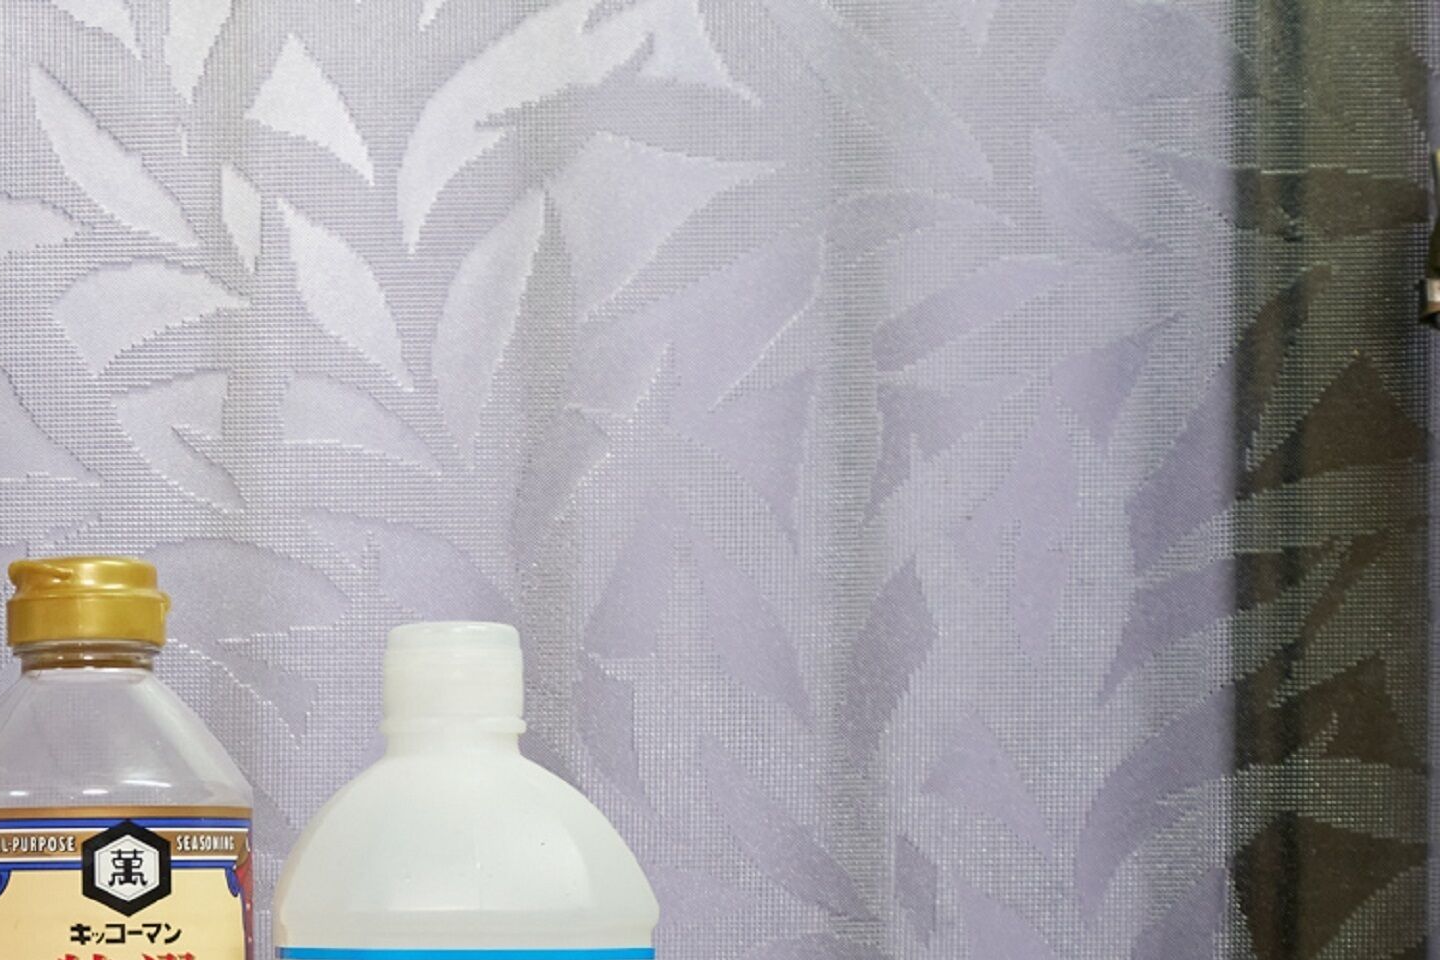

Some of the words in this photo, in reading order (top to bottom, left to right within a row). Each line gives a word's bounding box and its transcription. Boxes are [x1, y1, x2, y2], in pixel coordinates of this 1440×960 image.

[176, 835, 235, 851] SEASONING
[108, 849, 148, 888] 萬
[70, 923, 182, 945] キッコーマン
